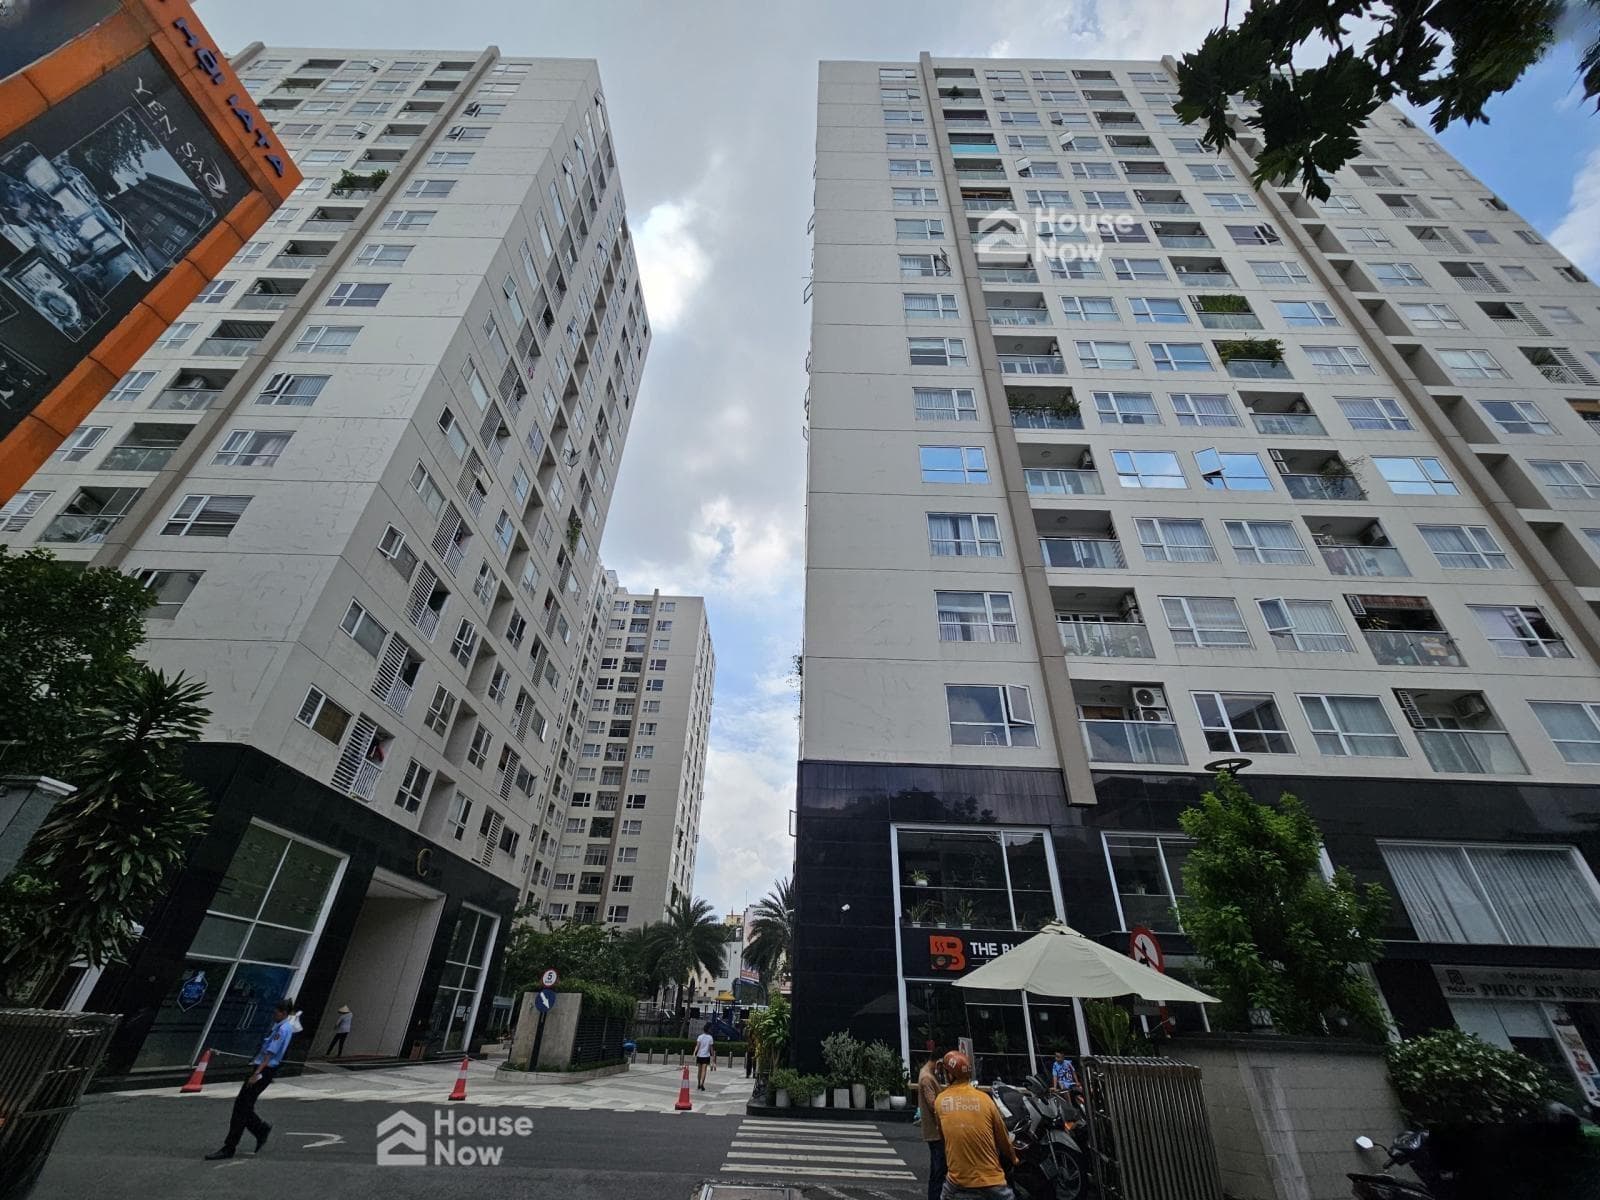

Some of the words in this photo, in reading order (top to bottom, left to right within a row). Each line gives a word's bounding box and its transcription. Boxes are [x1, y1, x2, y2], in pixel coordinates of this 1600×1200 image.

[228, 95, 285, 178] IATA
[417, 848, 432, 877] C
[970, 942, 998, 956] THE
[548, 971, 553, 981] 5
[955, 1103, 980, 1112] Food
